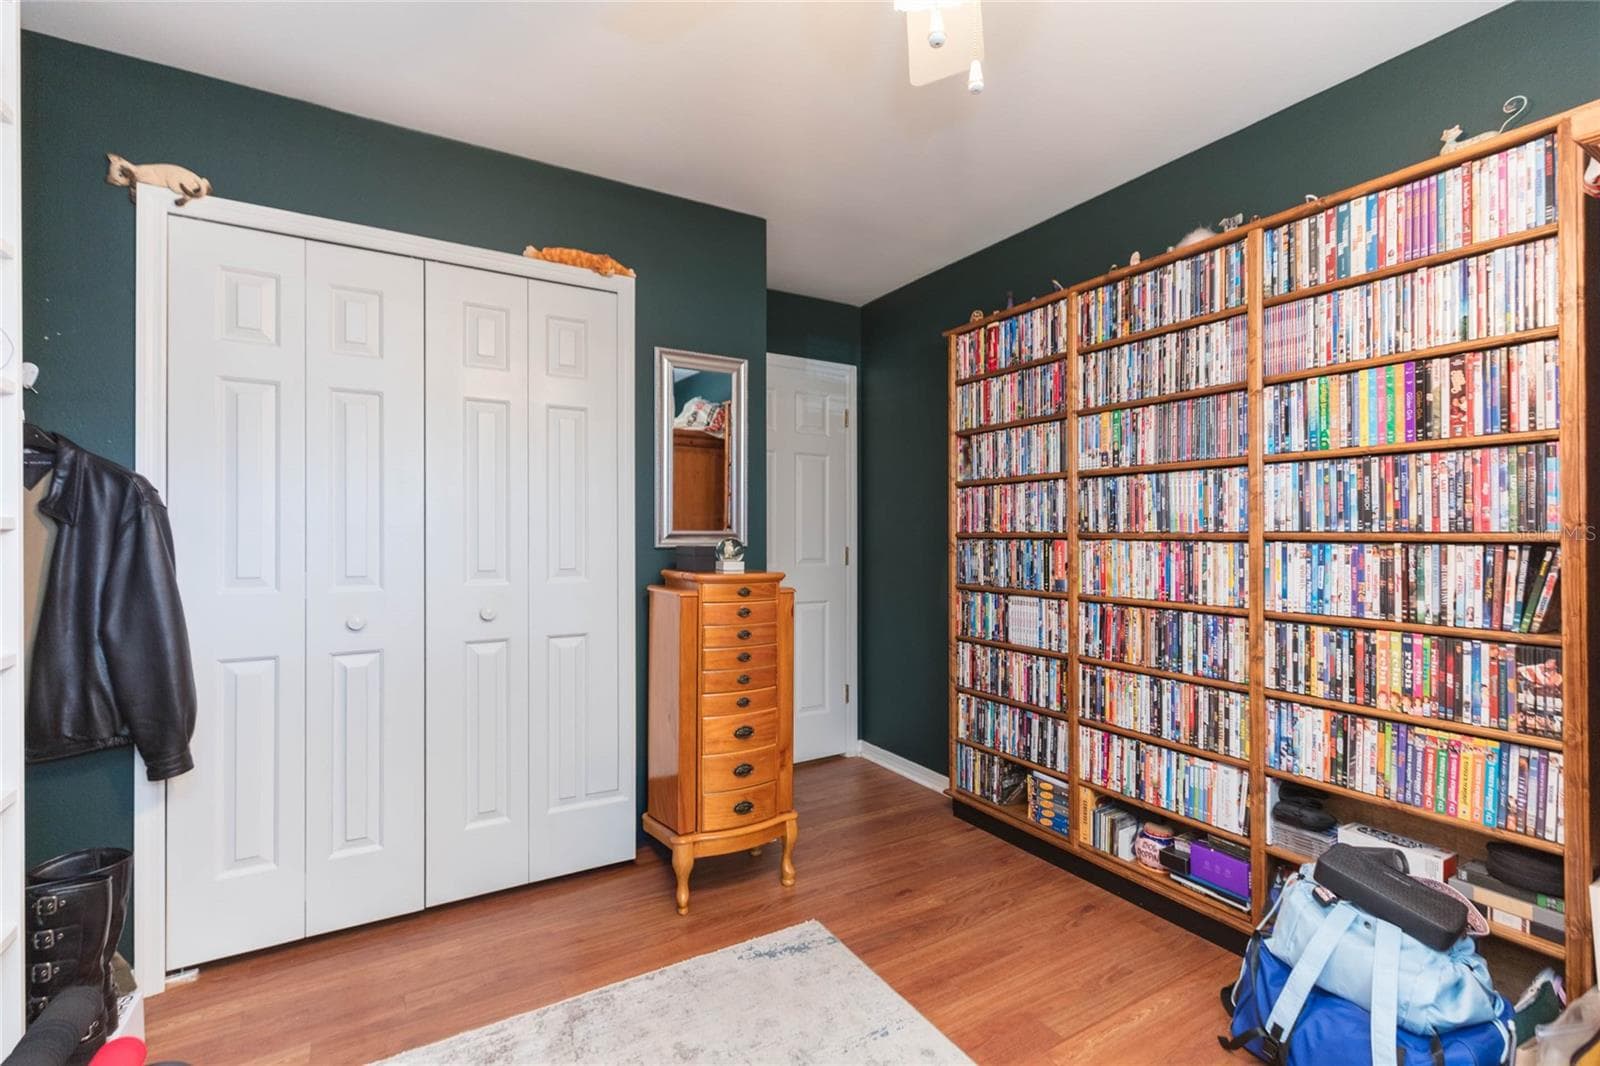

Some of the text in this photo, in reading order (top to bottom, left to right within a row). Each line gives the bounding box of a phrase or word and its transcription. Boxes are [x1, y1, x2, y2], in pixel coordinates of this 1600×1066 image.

[1380, 649, 1388, 686] reba
[1392, 650, 1400, 688] reba
[1404, 651, 1412, 689] reba
